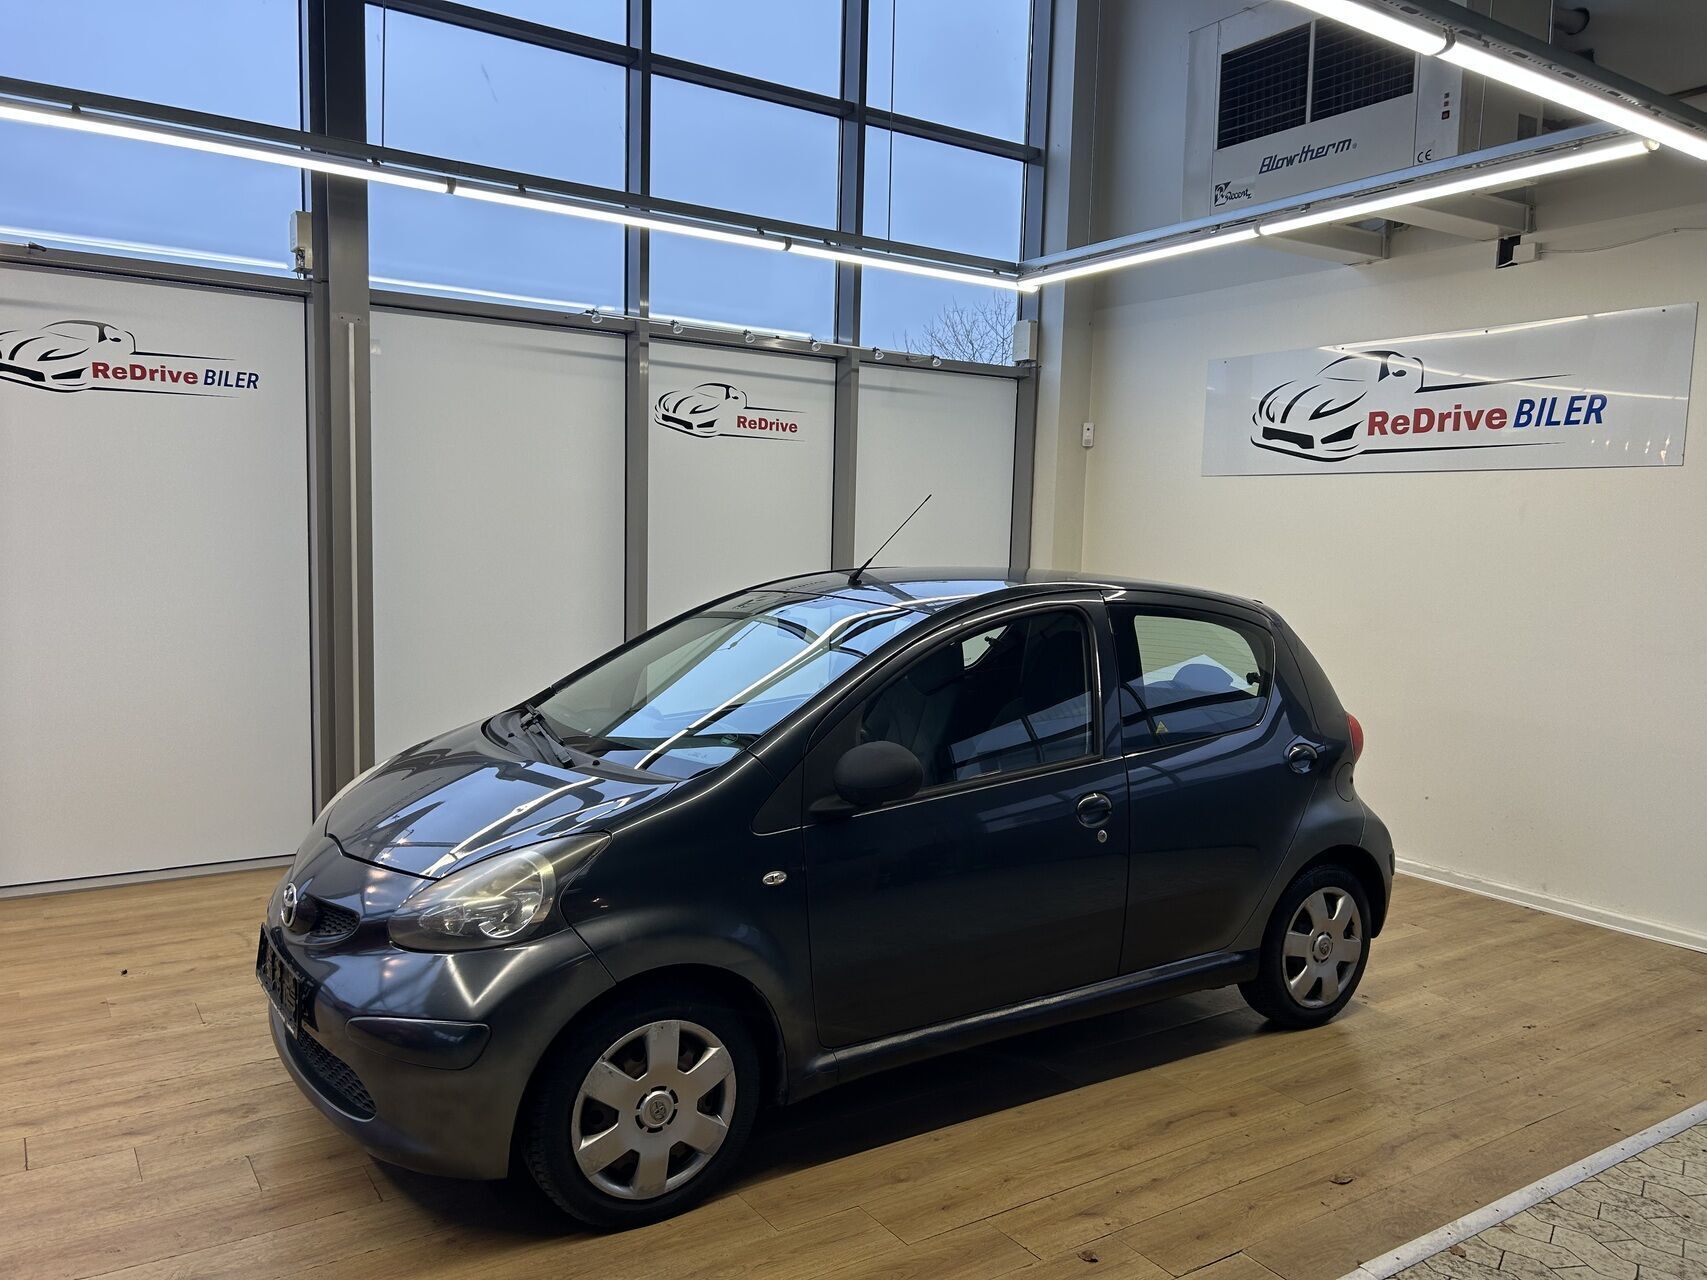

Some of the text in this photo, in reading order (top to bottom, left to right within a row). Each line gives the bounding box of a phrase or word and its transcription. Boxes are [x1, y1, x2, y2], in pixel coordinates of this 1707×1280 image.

[1258, 138, 1352, 175] Blowtherm
[1416, 148, 1433, 164] CE
[91, 361, 260, 390] ReDrive BILER
[736, 415, 799, 433] ReDrive
[1366, 393, 1608, 437] ReDrive BILER
